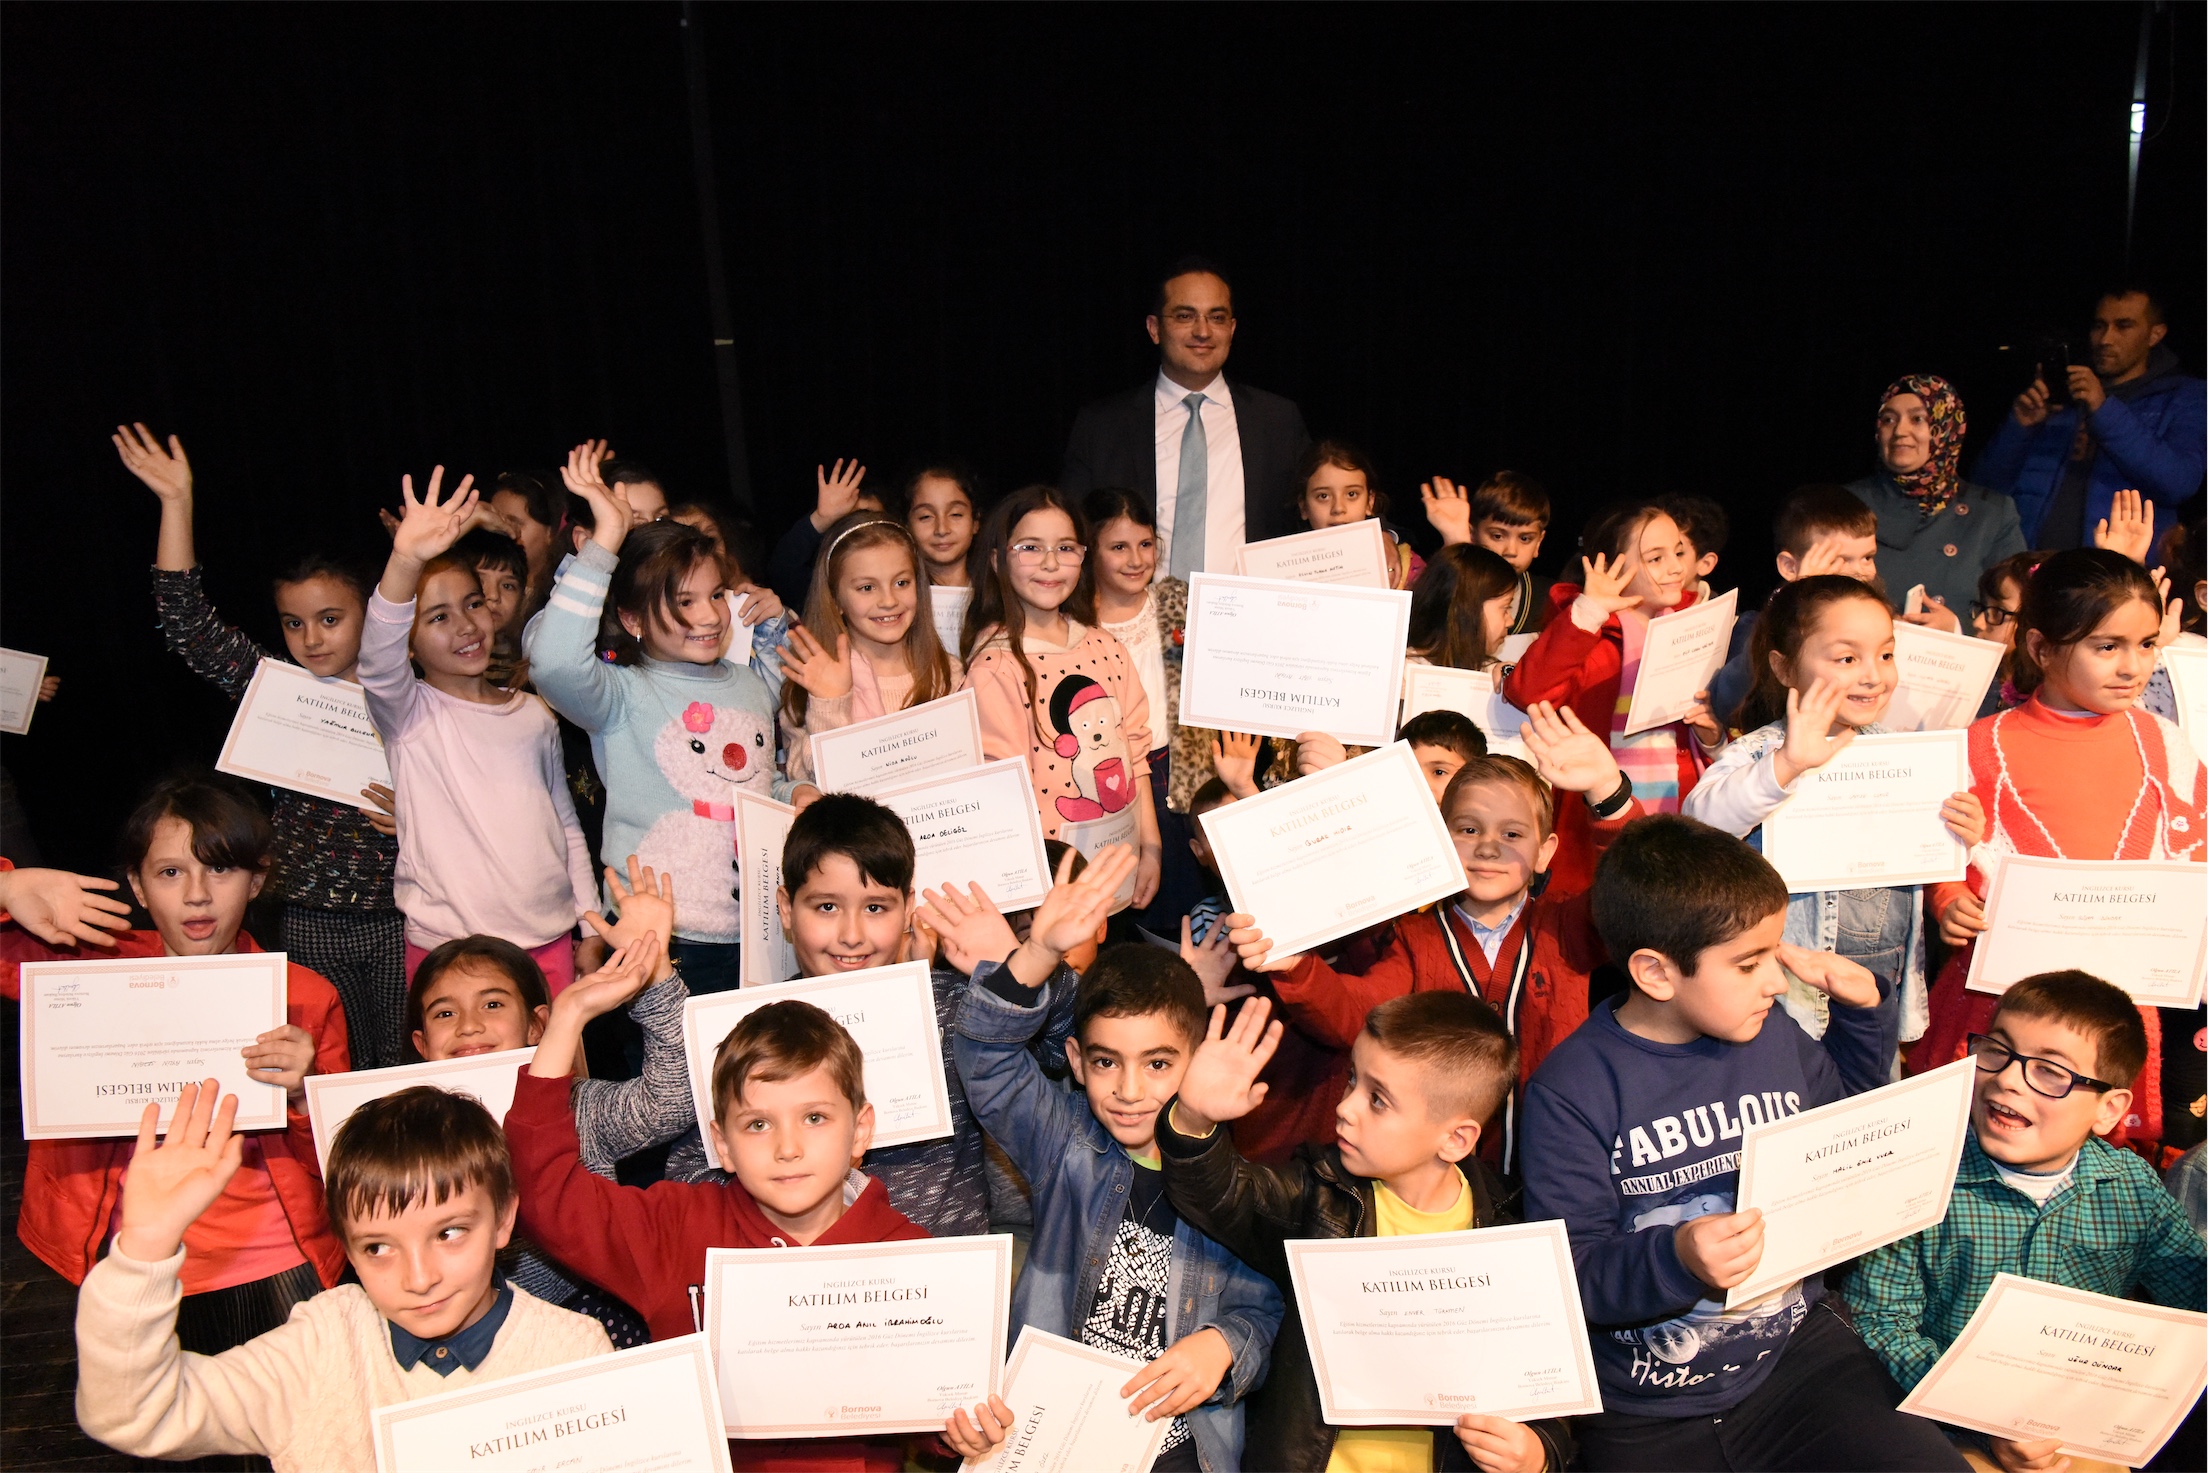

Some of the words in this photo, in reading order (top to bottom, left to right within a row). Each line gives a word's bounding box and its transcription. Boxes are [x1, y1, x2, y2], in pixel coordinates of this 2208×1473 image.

[1276, 556, 1310, 569] KATILIM
[1311, 549, 1344, 562] BELGESİ
[1240, 687, 1286, 702] BELGESİ
[1290, 693, 1340, 708] KATILIM
[296, 694, 338, 713] KATILIM
[861, 741, 900, 759] KATILIM
[902, 729, 938, 747] BELGESİ
[1818, 771, 1865, 783] KATILIM
[1868, 768, 1912, 780] BELGESİ
[902, 812, 935, 828] TILIM
[937, 799, 981, 819] BELGESİ
[1269, 812, 1320, 838] KATILIM
[1320, 792, 1368, 819] BELGESİ
[761, 848, 769, 892] BELGESİ
[1344, 895, 1376, 911] Bornova
[2053, 892, 2105, 904] KATILIM
[2109, 893, 2157, 904] BELGESİ
[128, 981, 165, 989] Bornova
[835, 1010, 865, 1027] GESİ
[96, 1083, 152, 1098] BELGESİ
[151, 1096, 180, 1104] GİLİZCE
[1805, 1138, 1858, 1164] KATILIM
[1862, 1116, 1911, 1145] BELGESİ
[1621, 1169, 1673, 1195] ANNUAL
[1674, 1150, 1743, 1189] EXPERIENC
[1388, 1268, 1428, 1277] İNGİLİZCE
[1430, 1266, 1456, 1275] KURSU
[823, 1279, 865, 1289] İNGİLİZCE
[868, 1277, 896, 1286] KURSU
[1362, 1280, 1424, 1293] KATILIM
[1429, 1272, 1491, 1291] BELGESİ
[788, 1292, 857, 1307] KATILIM
[864, 1285, 927, 1303] BELGESİ
[1379, 1308, 1398, 1318] Sayın
[799, 1323, 822, 1333] Sayın
[2111, 1330, 2135, 1339] KURSU
[2039, 1325, 2098, 1346] KATILIM
[2100, 1338, 2156, 1357] BELGESİ
[1437, 1393, 1476, 1404] Bornova
[1439, 1399, 1478, 1411] Belediyesi
[505, 1411, 553, 1430] İNGİLİZCE
[556, 1403, 587, 1418] KURSU
[840, 1411, 881, 1421] Belediyesi
[841, 1405, 882, 1414] Bornova
[470, 1428, 548, 1459] KATILIM
[554, 1405, 626, 1438] BELGESİ
[1014, 1405, 1046, 1457] BELGESİ
[2025, 1418, 2061, 1432] Bornova
[1004, 1427, 1020, 1450] KURSU
